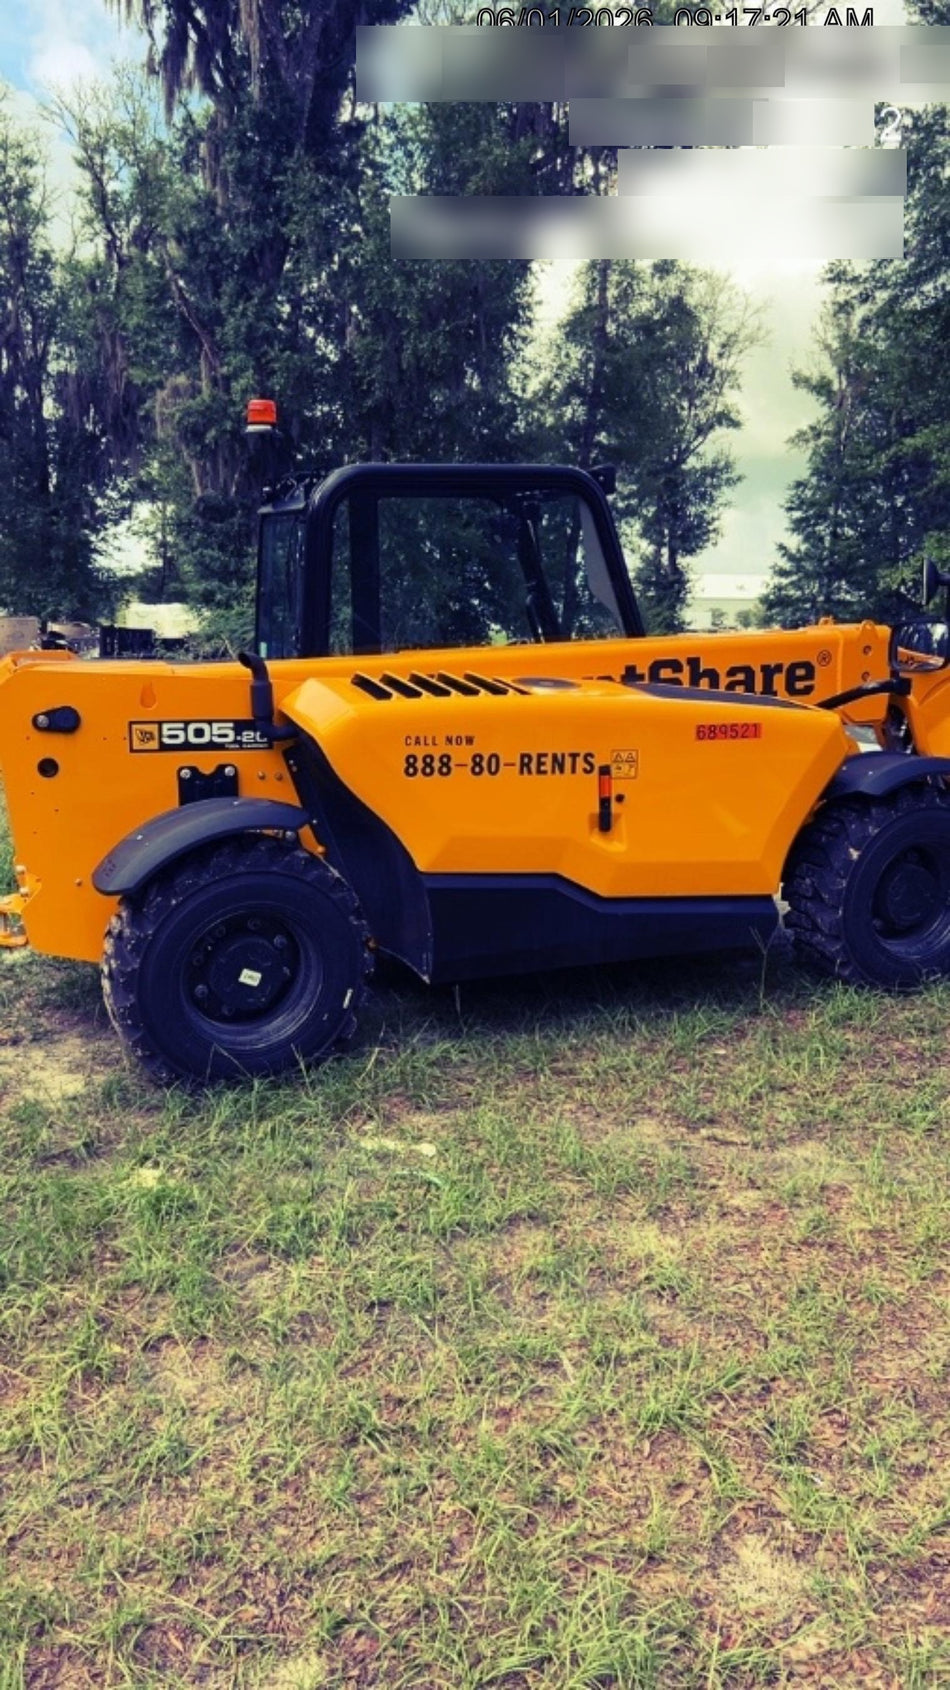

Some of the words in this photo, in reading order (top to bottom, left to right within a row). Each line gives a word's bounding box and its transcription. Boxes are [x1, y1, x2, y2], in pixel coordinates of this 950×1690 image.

[696, 722, 759, 740] 689521
[404, 735, 438, 746] CALL
[445, 735, 475, 746] NOW
[404, 752, 596, 778] 888-80-RENTS
